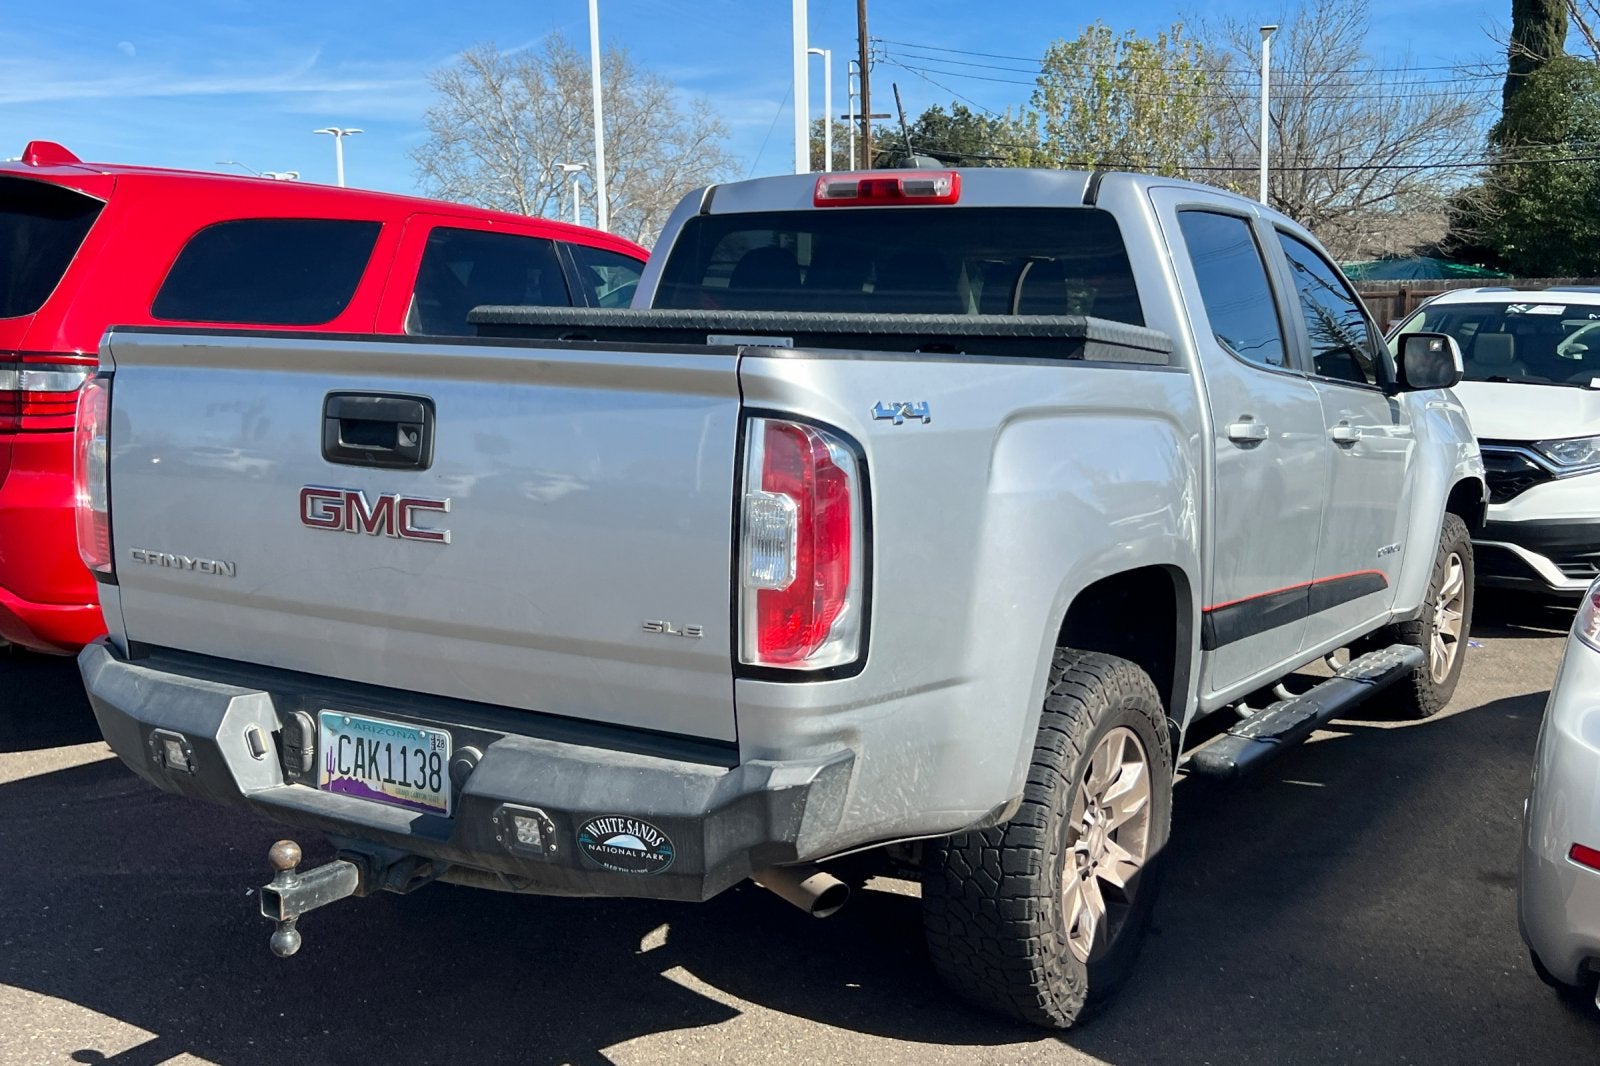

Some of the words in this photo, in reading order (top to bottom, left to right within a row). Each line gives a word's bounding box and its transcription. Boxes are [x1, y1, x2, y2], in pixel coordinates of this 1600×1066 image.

[300, 484, 450, 543] GMC
[130, 547, 236, 578] CANYON
[642, 619, 704, 639] SLE
[353, 721, 417, 741] ARIZONA
[337, 734, 441, 793] CAK1138
[585, 818, 625, 838] WHITE
[626, 819, 665, 847] SANDS
[588, 844, 637, 857] NATIONAL
[641, 851, 664, 861] PARK
